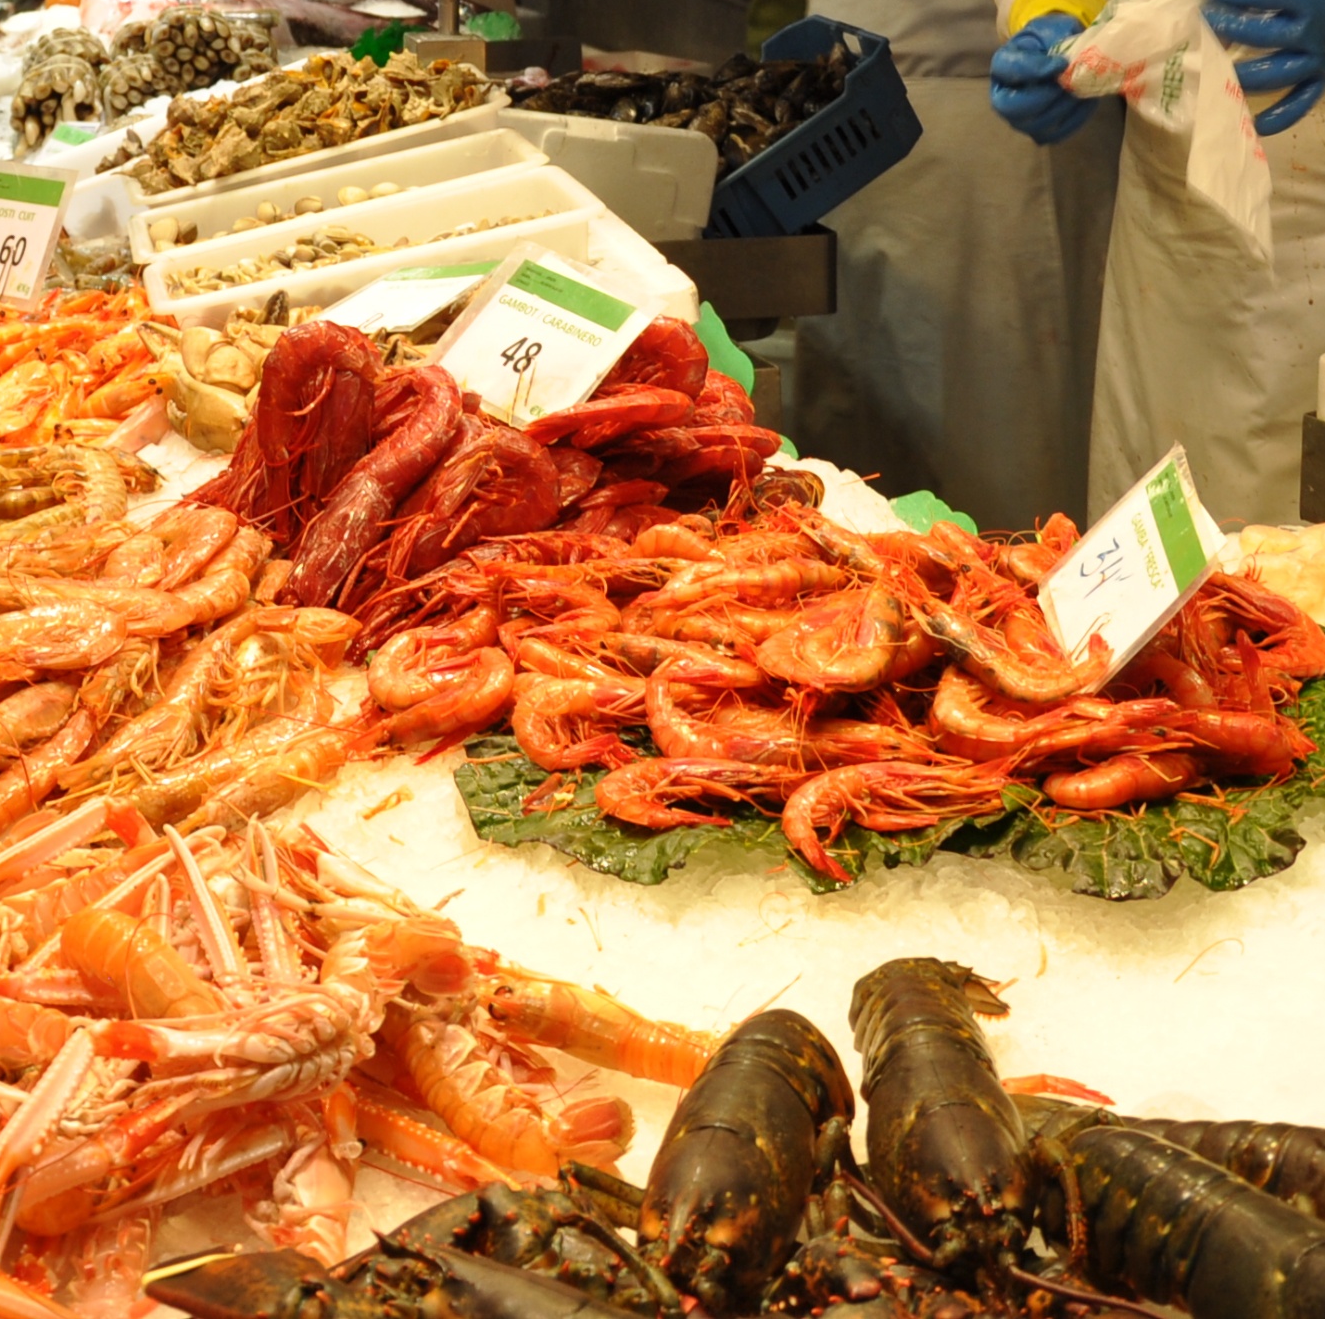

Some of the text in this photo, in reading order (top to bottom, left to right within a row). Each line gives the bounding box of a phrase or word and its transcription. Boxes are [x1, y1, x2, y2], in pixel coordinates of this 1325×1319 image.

[17, 209, 37, 223] CUIT
[498, 293, 539, 318] GAMBOT
[542, 313, 603, 348] CARABINERO
[499, 336, 543, 374] 48
